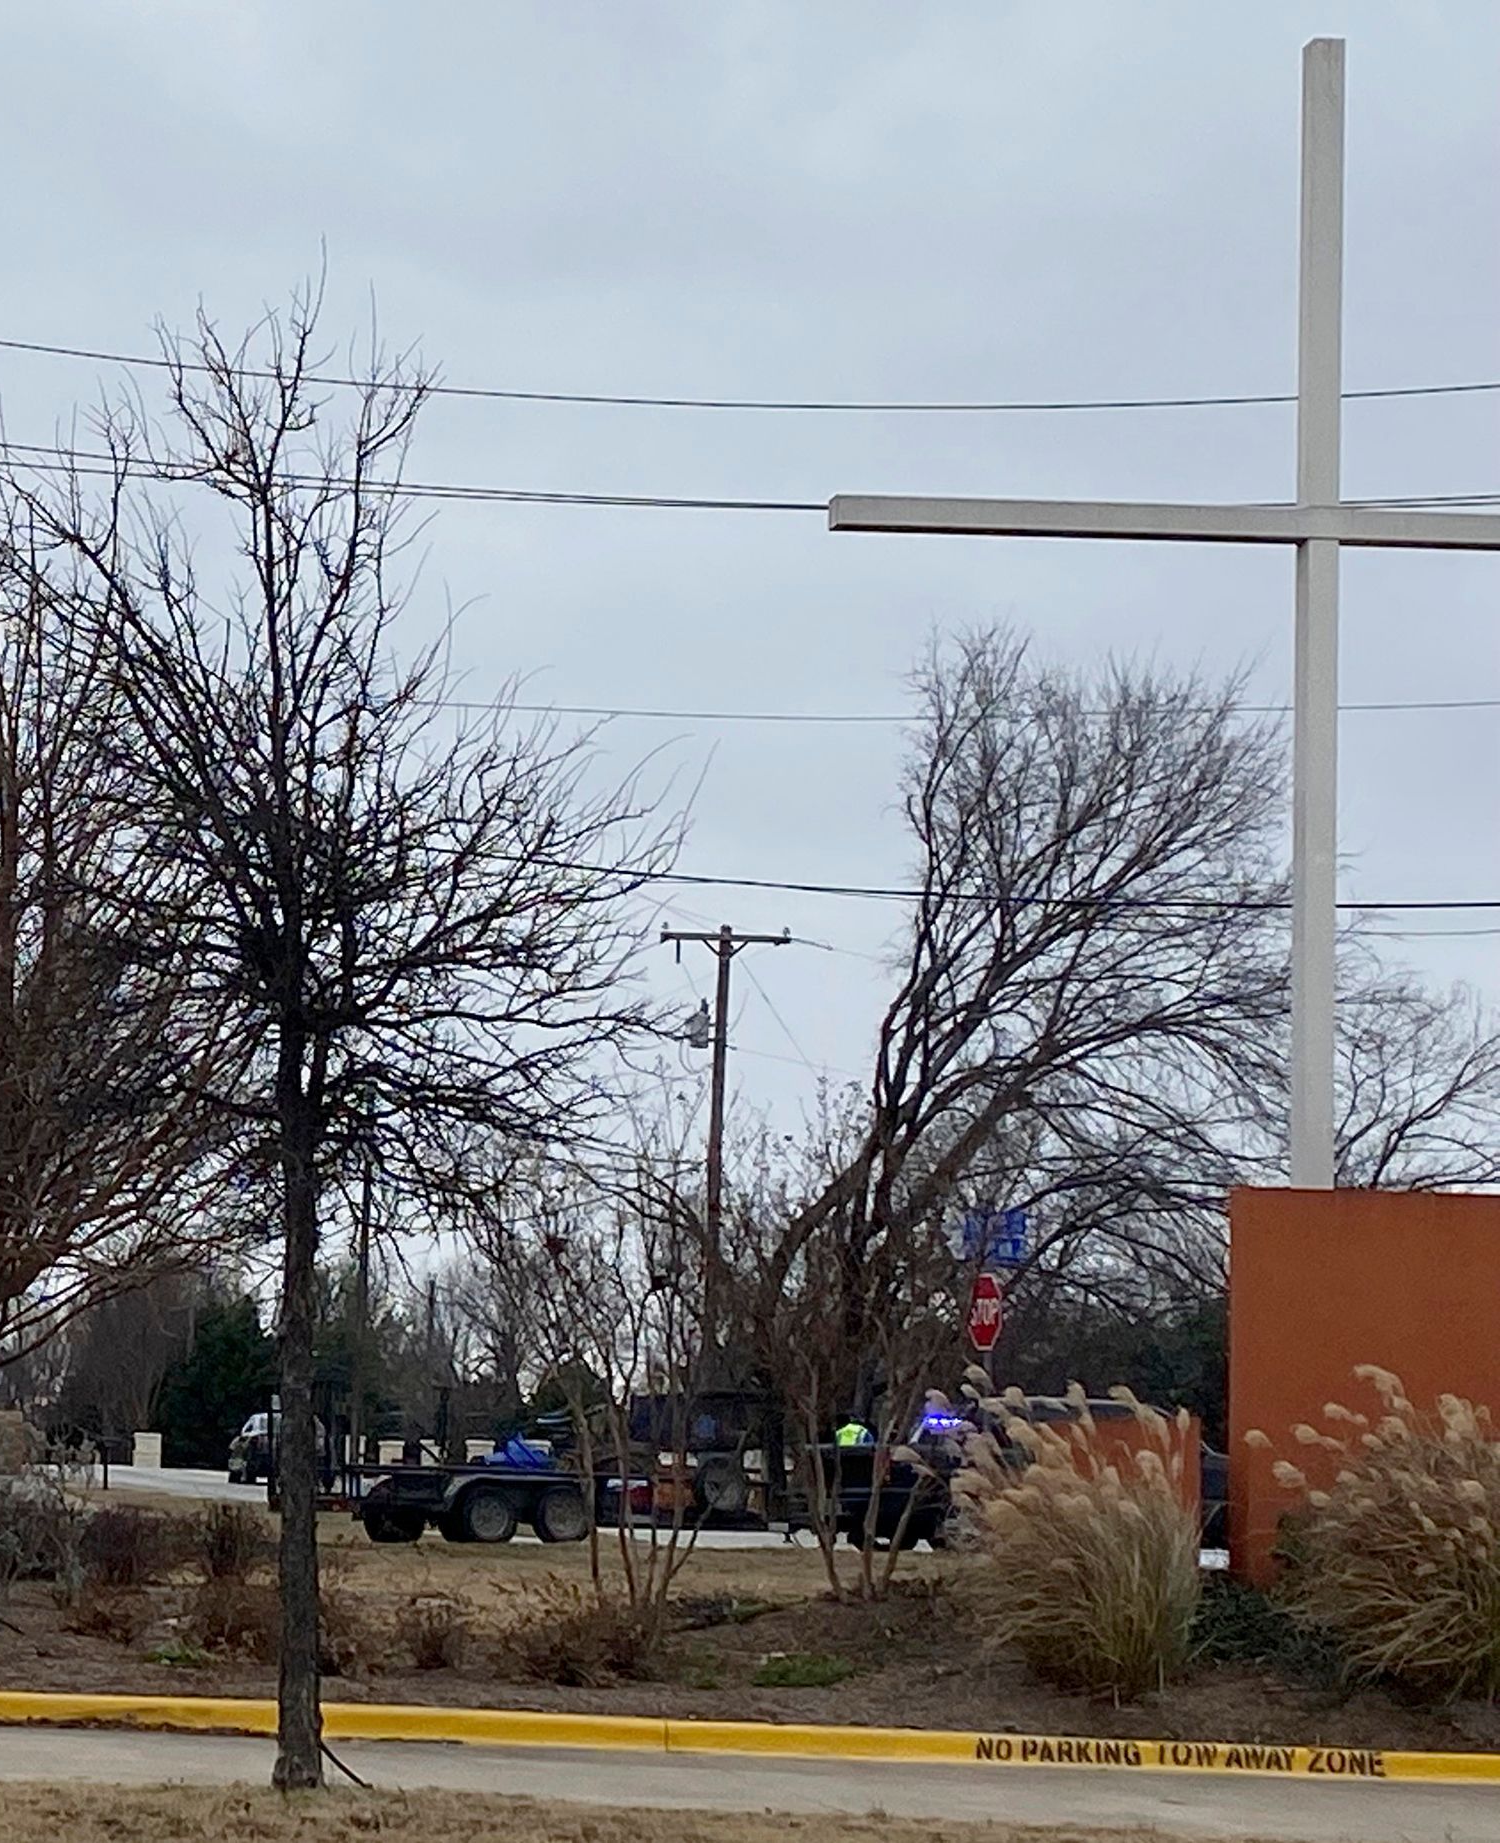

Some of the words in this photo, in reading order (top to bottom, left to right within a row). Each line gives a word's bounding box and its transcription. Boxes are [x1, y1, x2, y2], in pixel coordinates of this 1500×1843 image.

[970, 1298, 999, 1326] STOP
[976, 1738, 1012, 1761] NO
[1022, 1739, 1141, 1766] PARKING
[1155, 1743, 1217, 1767] TOW
[1225, 1747, 1296, 1772] AWAY
[1308, 1750, 1386, 1777] ZONE
